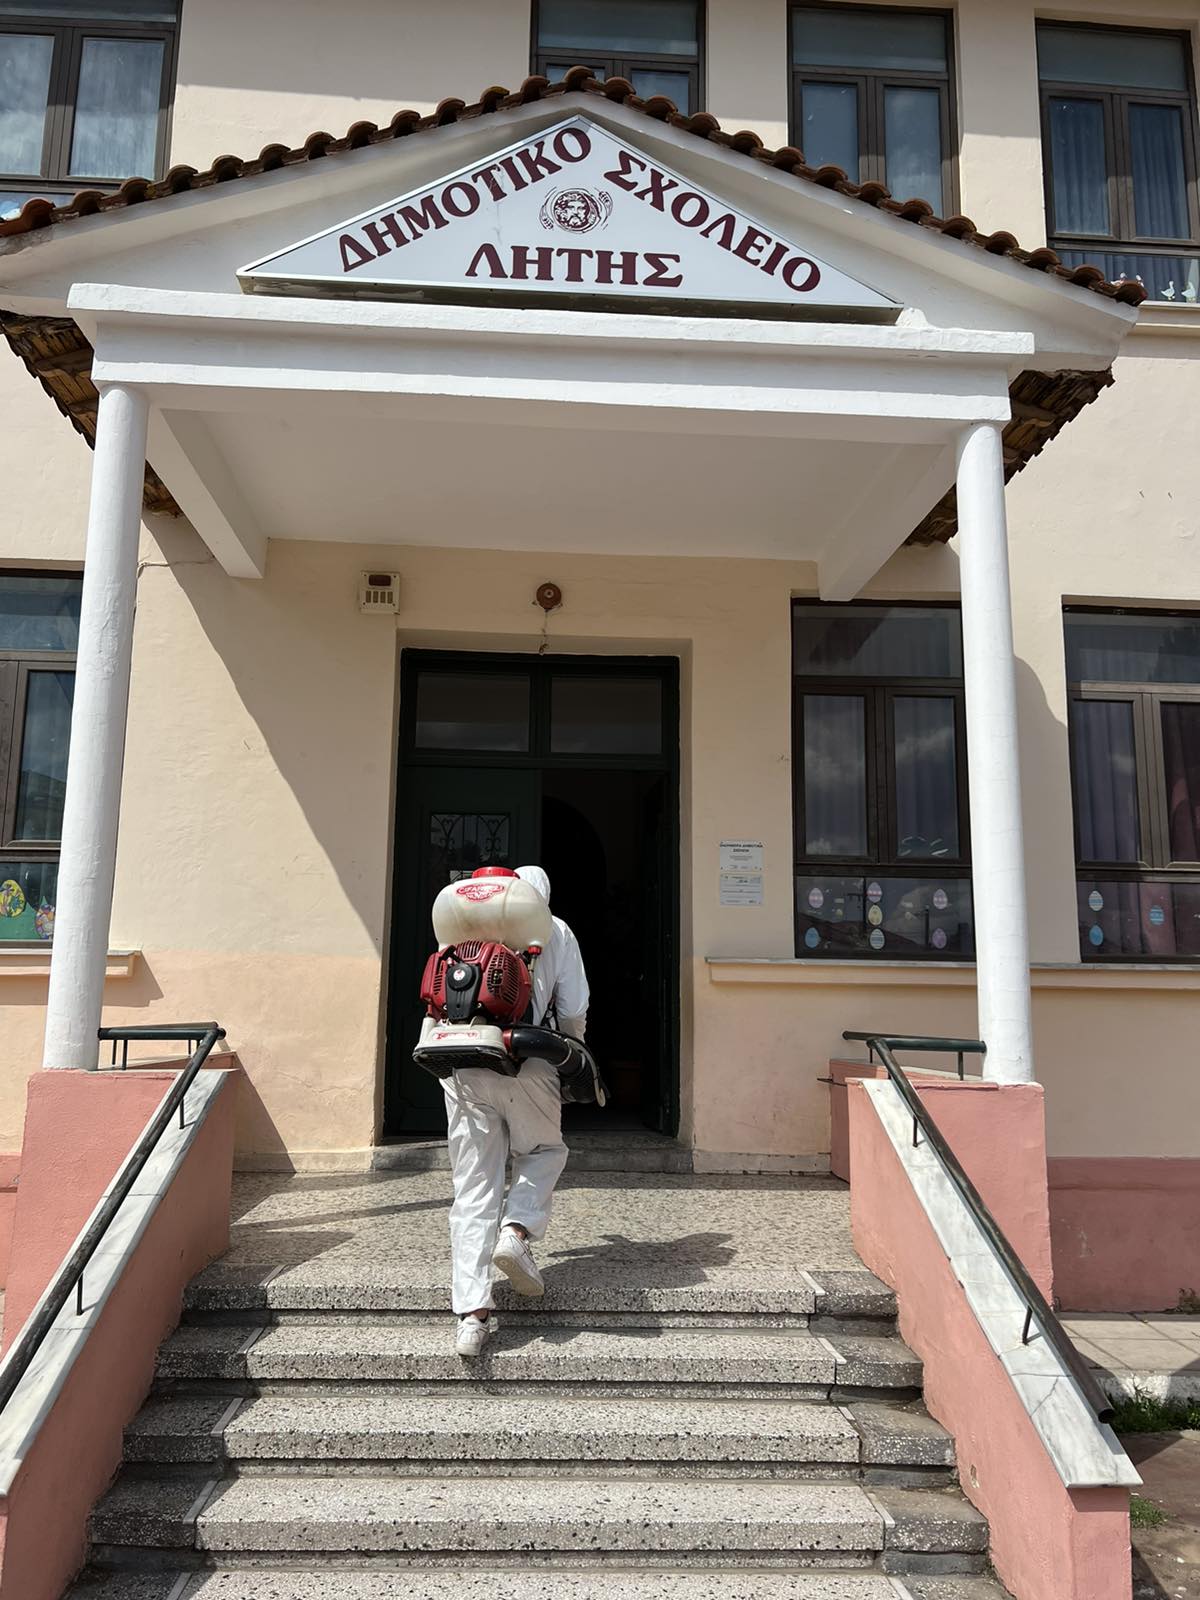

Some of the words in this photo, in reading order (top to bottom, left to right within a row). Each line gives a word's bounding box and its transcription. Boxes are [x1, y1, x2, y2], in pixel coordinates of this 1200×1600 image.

[340, 128, 591, 271] ΔΗΜΟΤΙΚΟ
[604, 150, 821, 292] ΣΧΟΛΕΙΟ
[466, 244, 681, 288] ΛΗΤΗΣ
